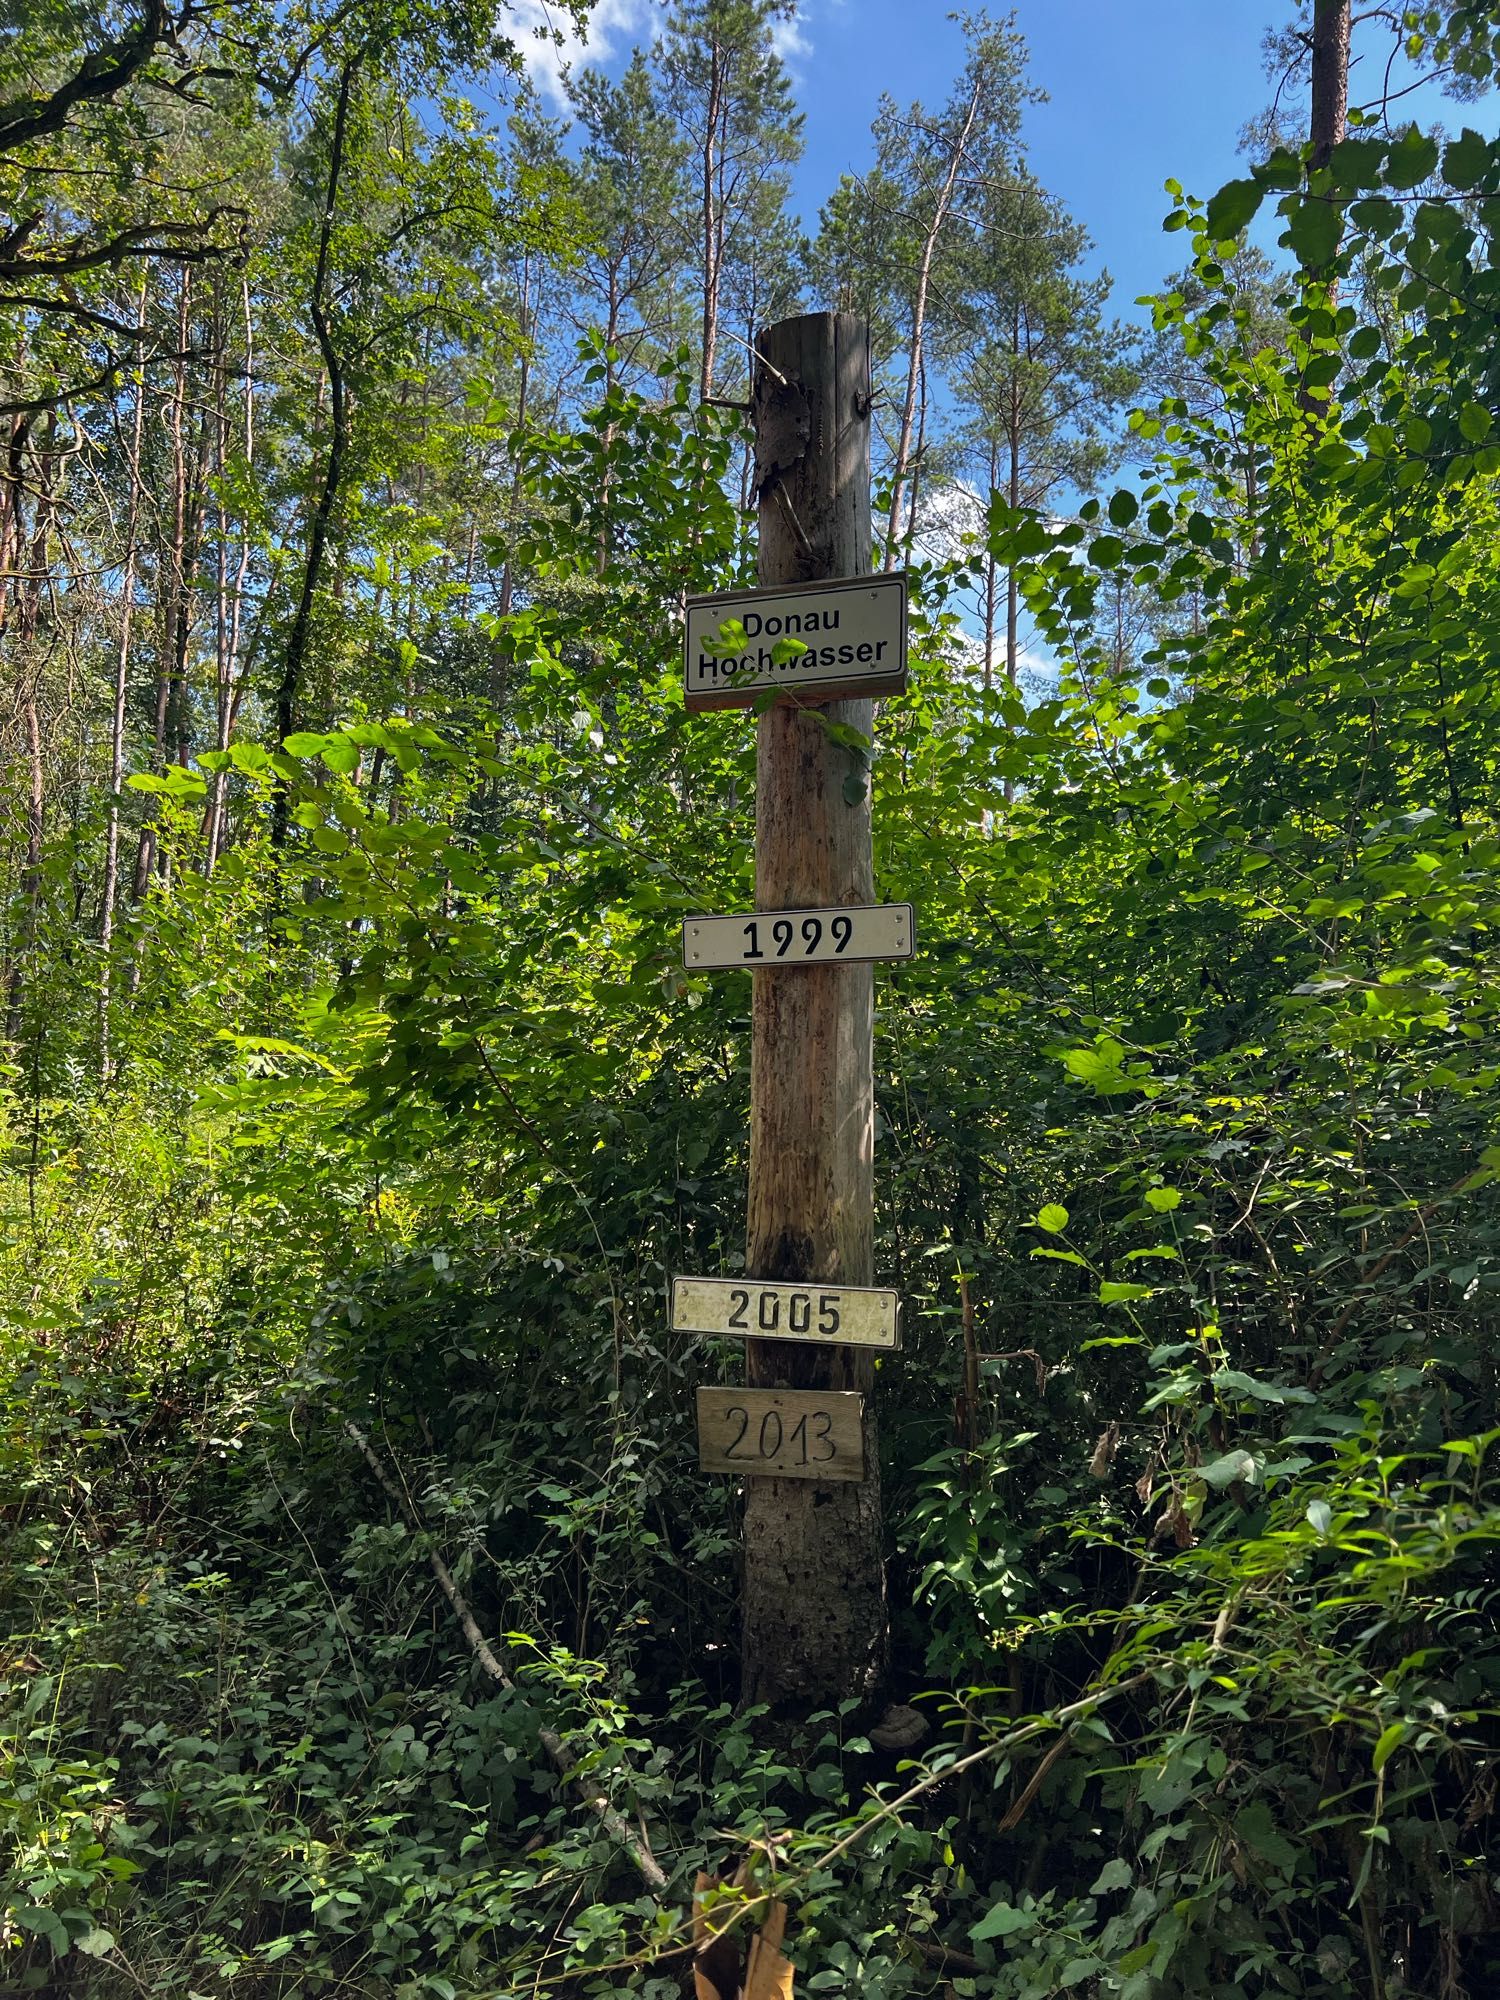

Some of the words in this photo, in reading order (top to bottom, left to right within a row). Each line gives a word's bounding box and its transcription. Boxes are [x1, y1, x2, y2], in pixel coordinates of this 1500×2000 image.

[742, 609, 840, 638] Donau
[743, 916, 853, 959] 1999
[728, 1289, 841, 1335] 2005
[724, 1407, 836, 1466] 2013
